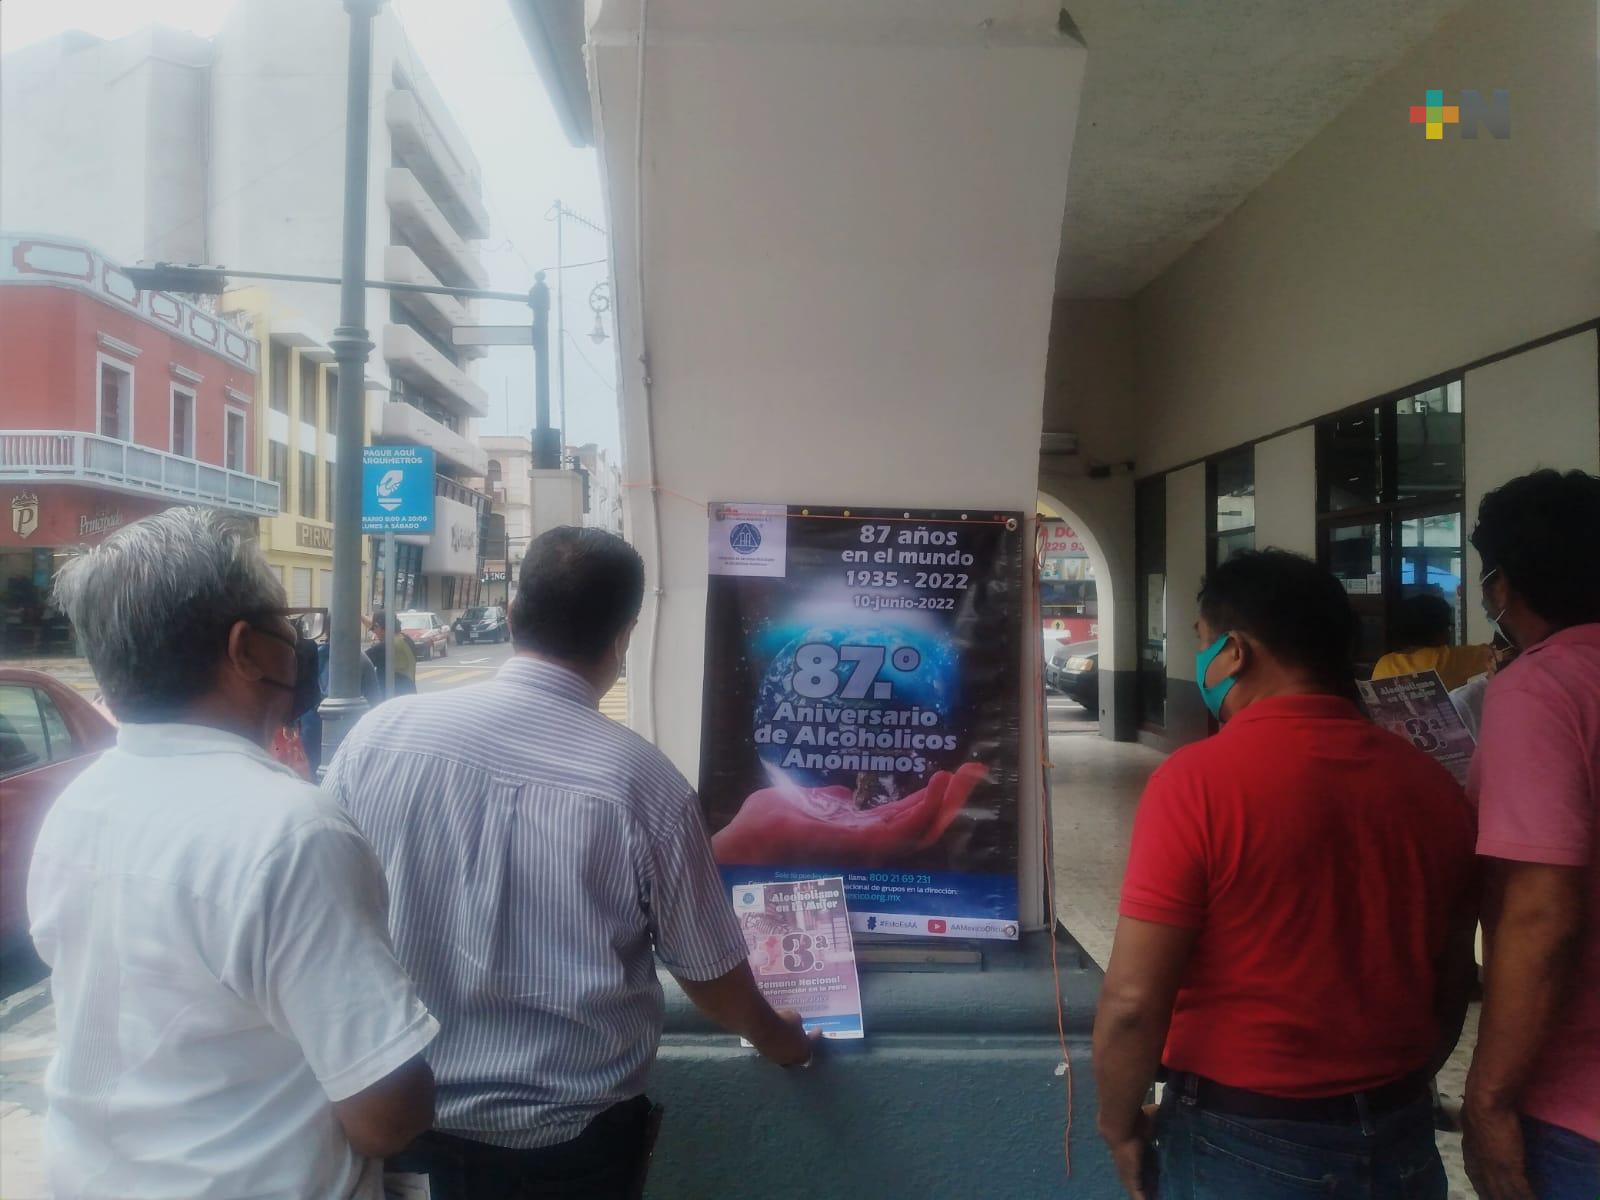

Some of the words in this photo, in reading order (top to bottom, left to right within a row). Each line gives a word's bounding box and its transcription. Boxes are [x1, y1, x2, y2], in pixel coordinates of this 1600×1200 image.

[363, 449, 393, 457] PAGUE
[18, 508, 34, 535] P
[302, 525, 333, 548] PIRM
[859, 524, 891, 544] 87
[898, 525, 958, 546] años
[841, 549, 870, 563] en
[873, 547, 893, 563] el
[898, 549, 974, 567] mundo
[846, 570, 898, 588] 1935
[914, 571, 969, 590] 2022
[854, 594, 956, 611] 10-junio-2022
[772, 701, 938, 727] Aniversario
[754, 723, 788, 745] de
[793, 725, 958, 751] Alcohólicos
[780, 748, 927, 774] Anónimos
[869, 873, 889, 883] 800
[890, 874, 900, 883] 21
[901, 874, 915, 884] 69
[916, 875, 932, 885] 231
[771, 888, 840, 903] Alcoholismo
[881, 886, 906, 894] grupos
[916, 886, 925, 894] la
[775, 904, 790, 913] en
[805, 898, 838, 913] Mujer
[758, 980, 797, 990] Semana
[798, 975, 841, 987] Nacional
